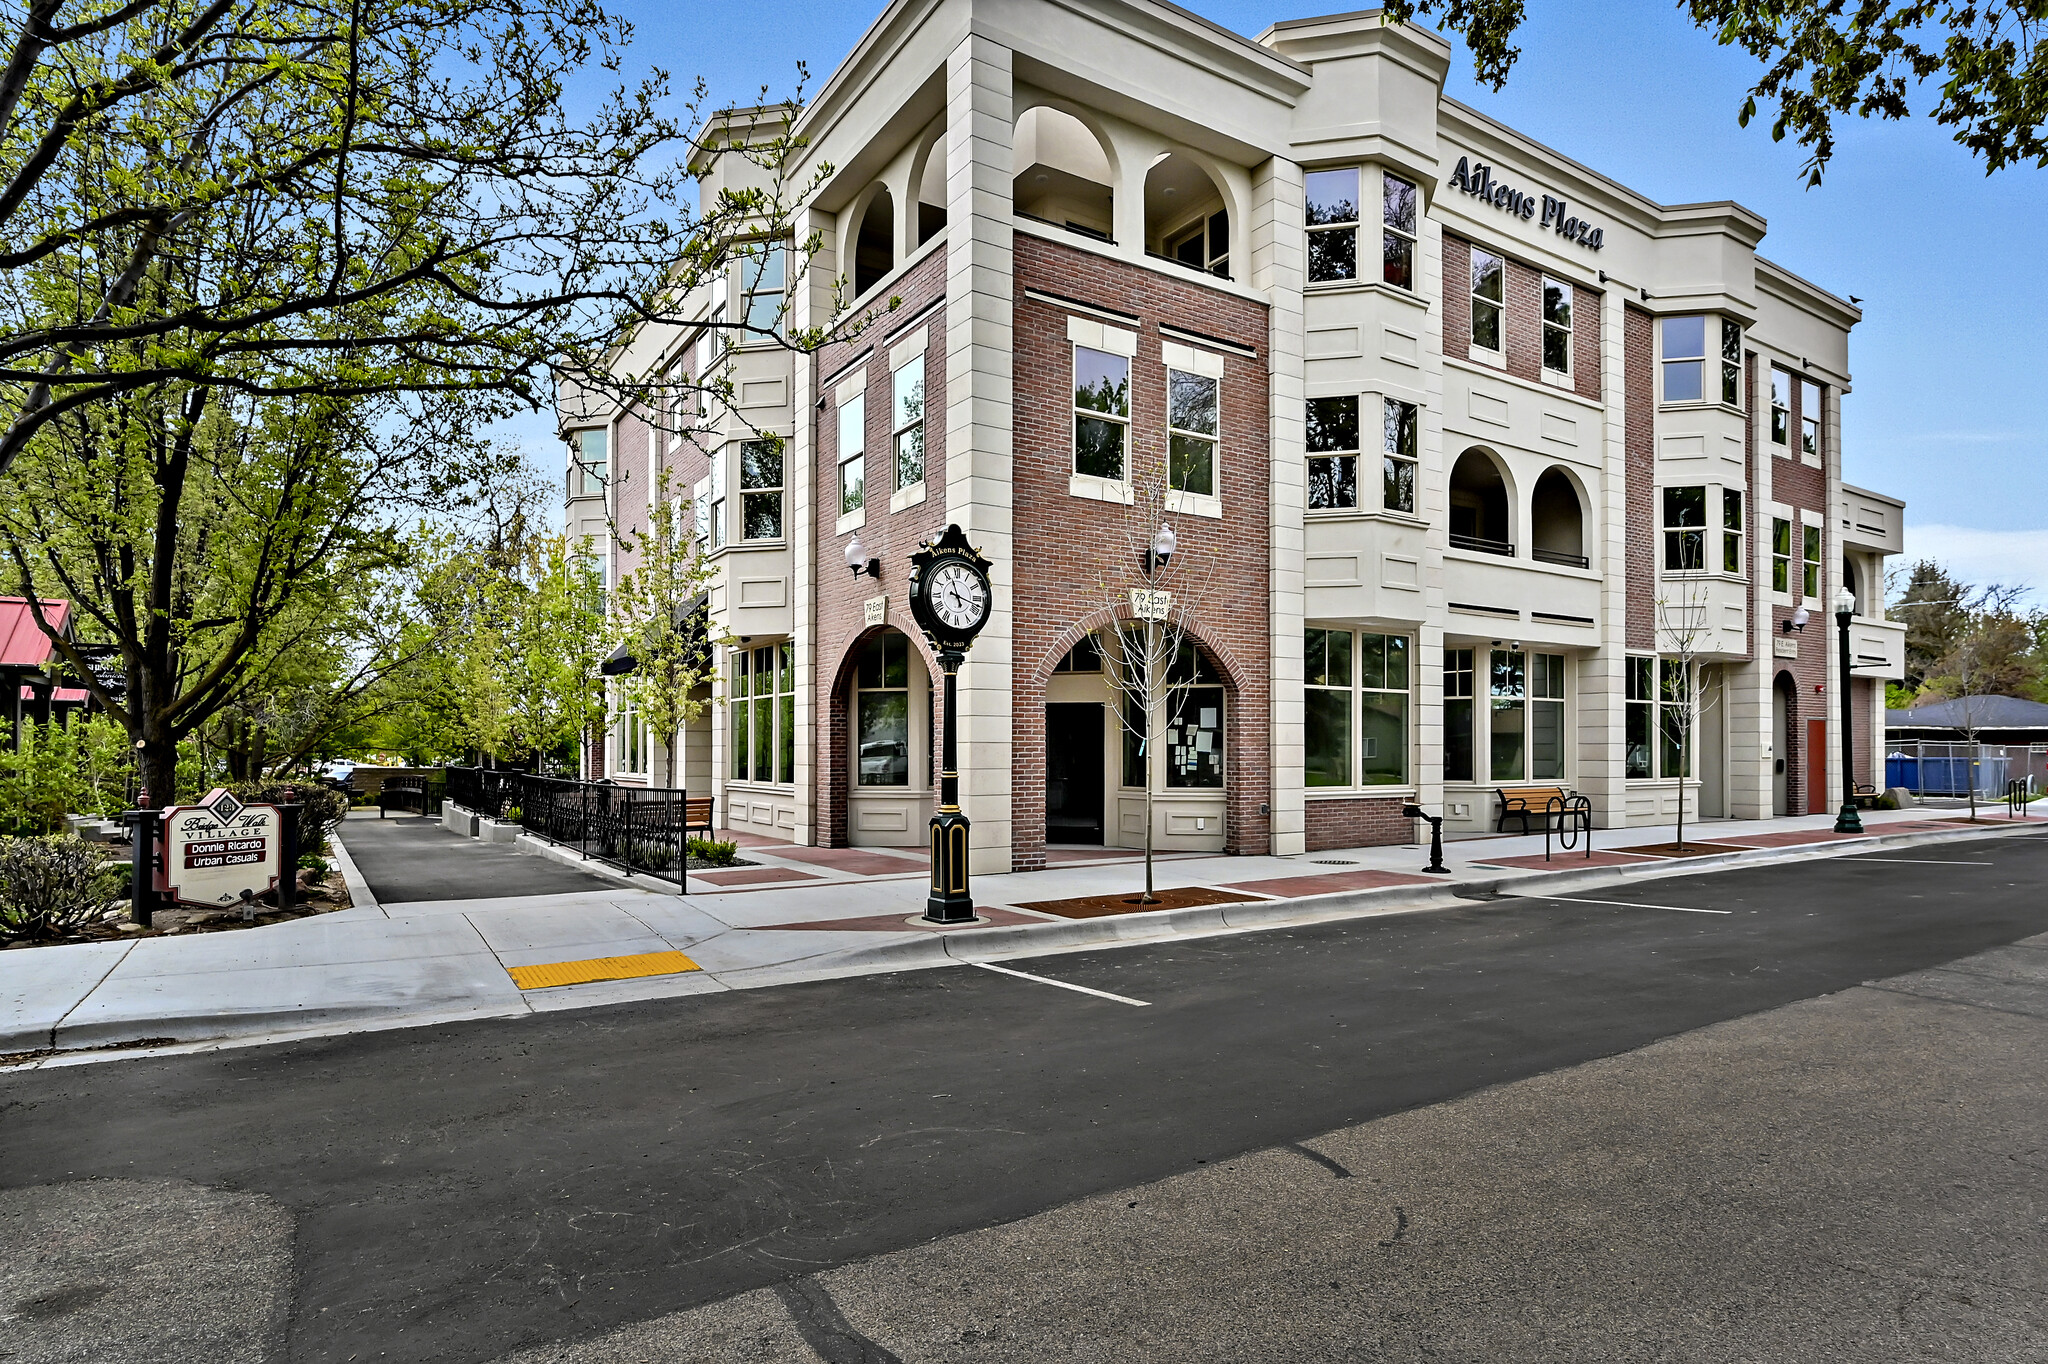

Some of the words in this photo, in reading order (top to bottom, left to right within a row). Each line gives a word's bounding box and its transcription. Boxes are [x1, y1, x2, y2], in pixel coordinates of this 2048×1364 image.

[1448, 155, 1536, 219] Aikens
[1539, 193, 1604, 250] Plaza
[931, 547, 956, 558] Aikens
[958, 547, 977, 562] Plaza
[1134, 592, 1146, 603] 79
[866, 602, 872, 613] 79
[872, 601, 884, 612] East
[238, 813, 269, 827] Walk
[186, 828, 261, 839] VILLAGE
[192, 843, 225, 853] Donnie
[227, 840, 262, 851] Ricardo
[193, 856, 223, 867] Urban
[226, 852, 259, 864] Casuals
